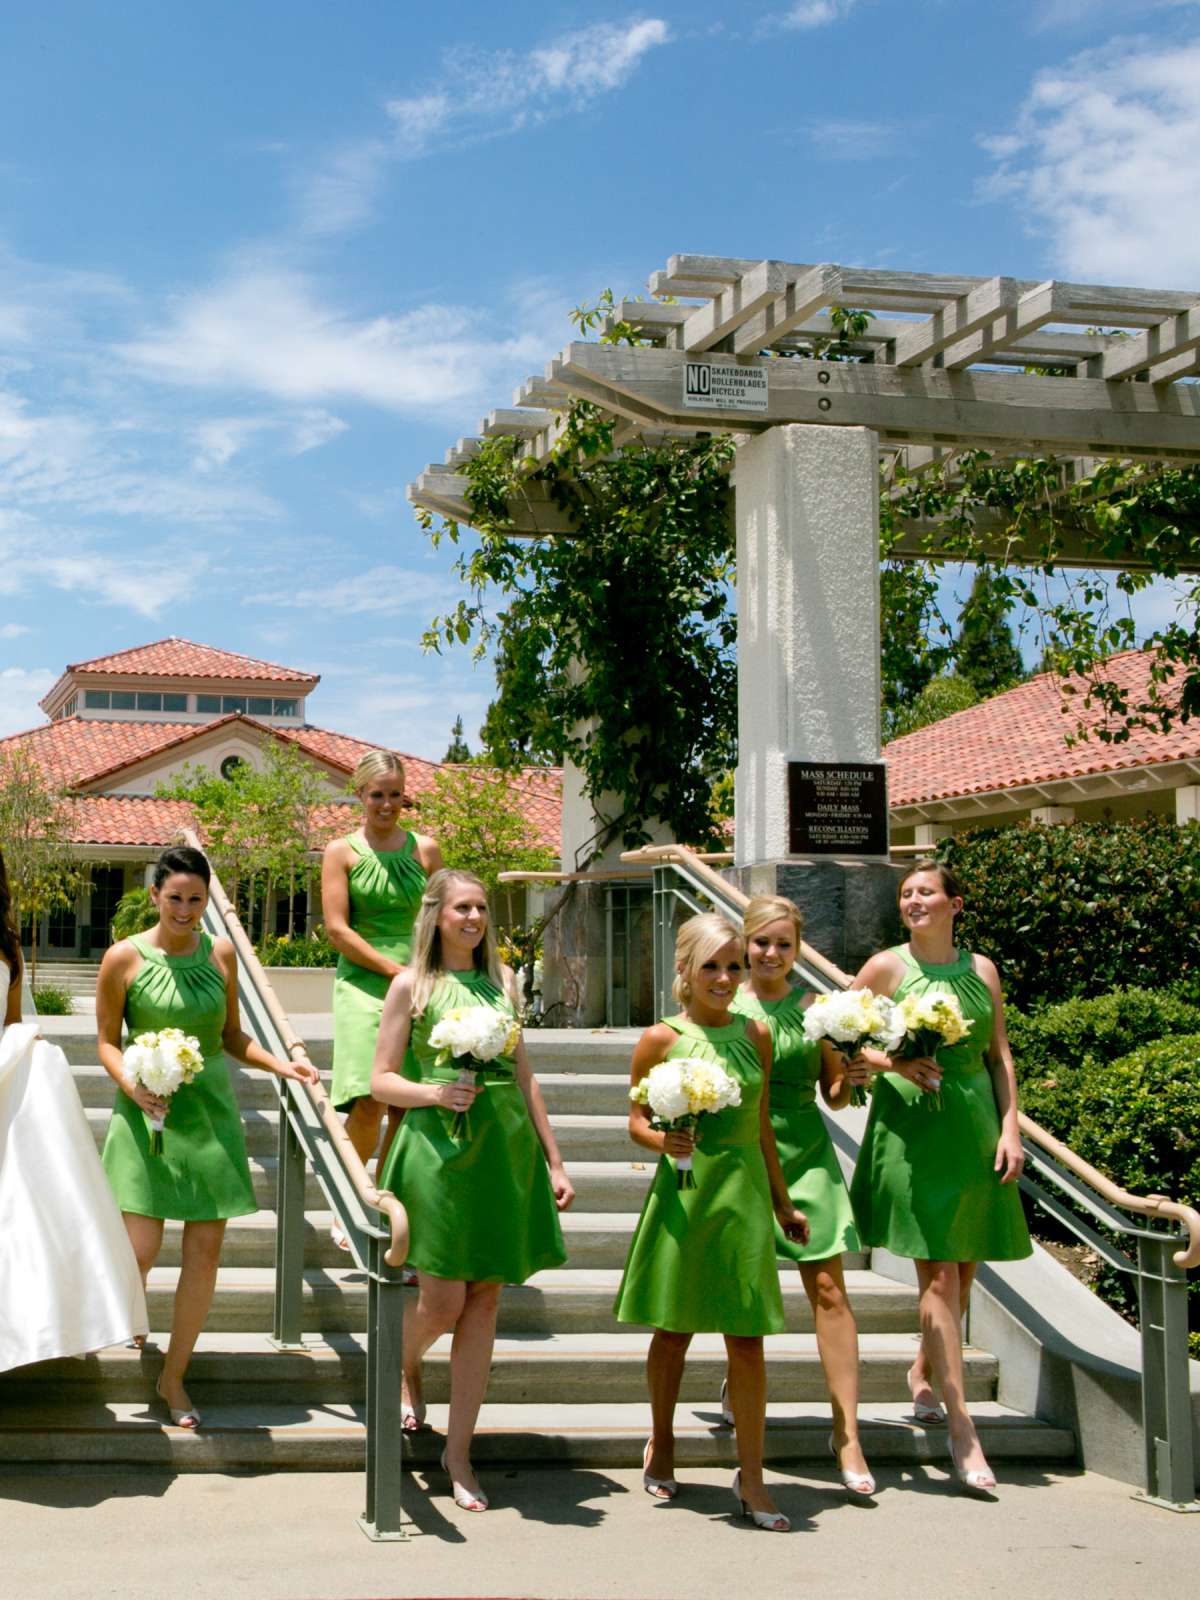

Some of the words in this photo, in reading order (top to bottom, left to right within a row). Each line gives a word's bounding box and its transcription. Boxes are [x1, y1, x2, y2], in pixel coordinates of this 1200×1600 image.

[711, 367, 763, 379] SKATEBOARDS
[687, 365, 710, 393] NO
[711, 377, 767, 389] ROLLERBLADES
[711, 387, 746, 397] BICYCLES
[801, 770, 825, 778] MASS
[826, 770, 874, 780] SCHEDULE
[840, 804, 860, 812] MASS
[808, 825, 869, 833] RECONCILIATION
